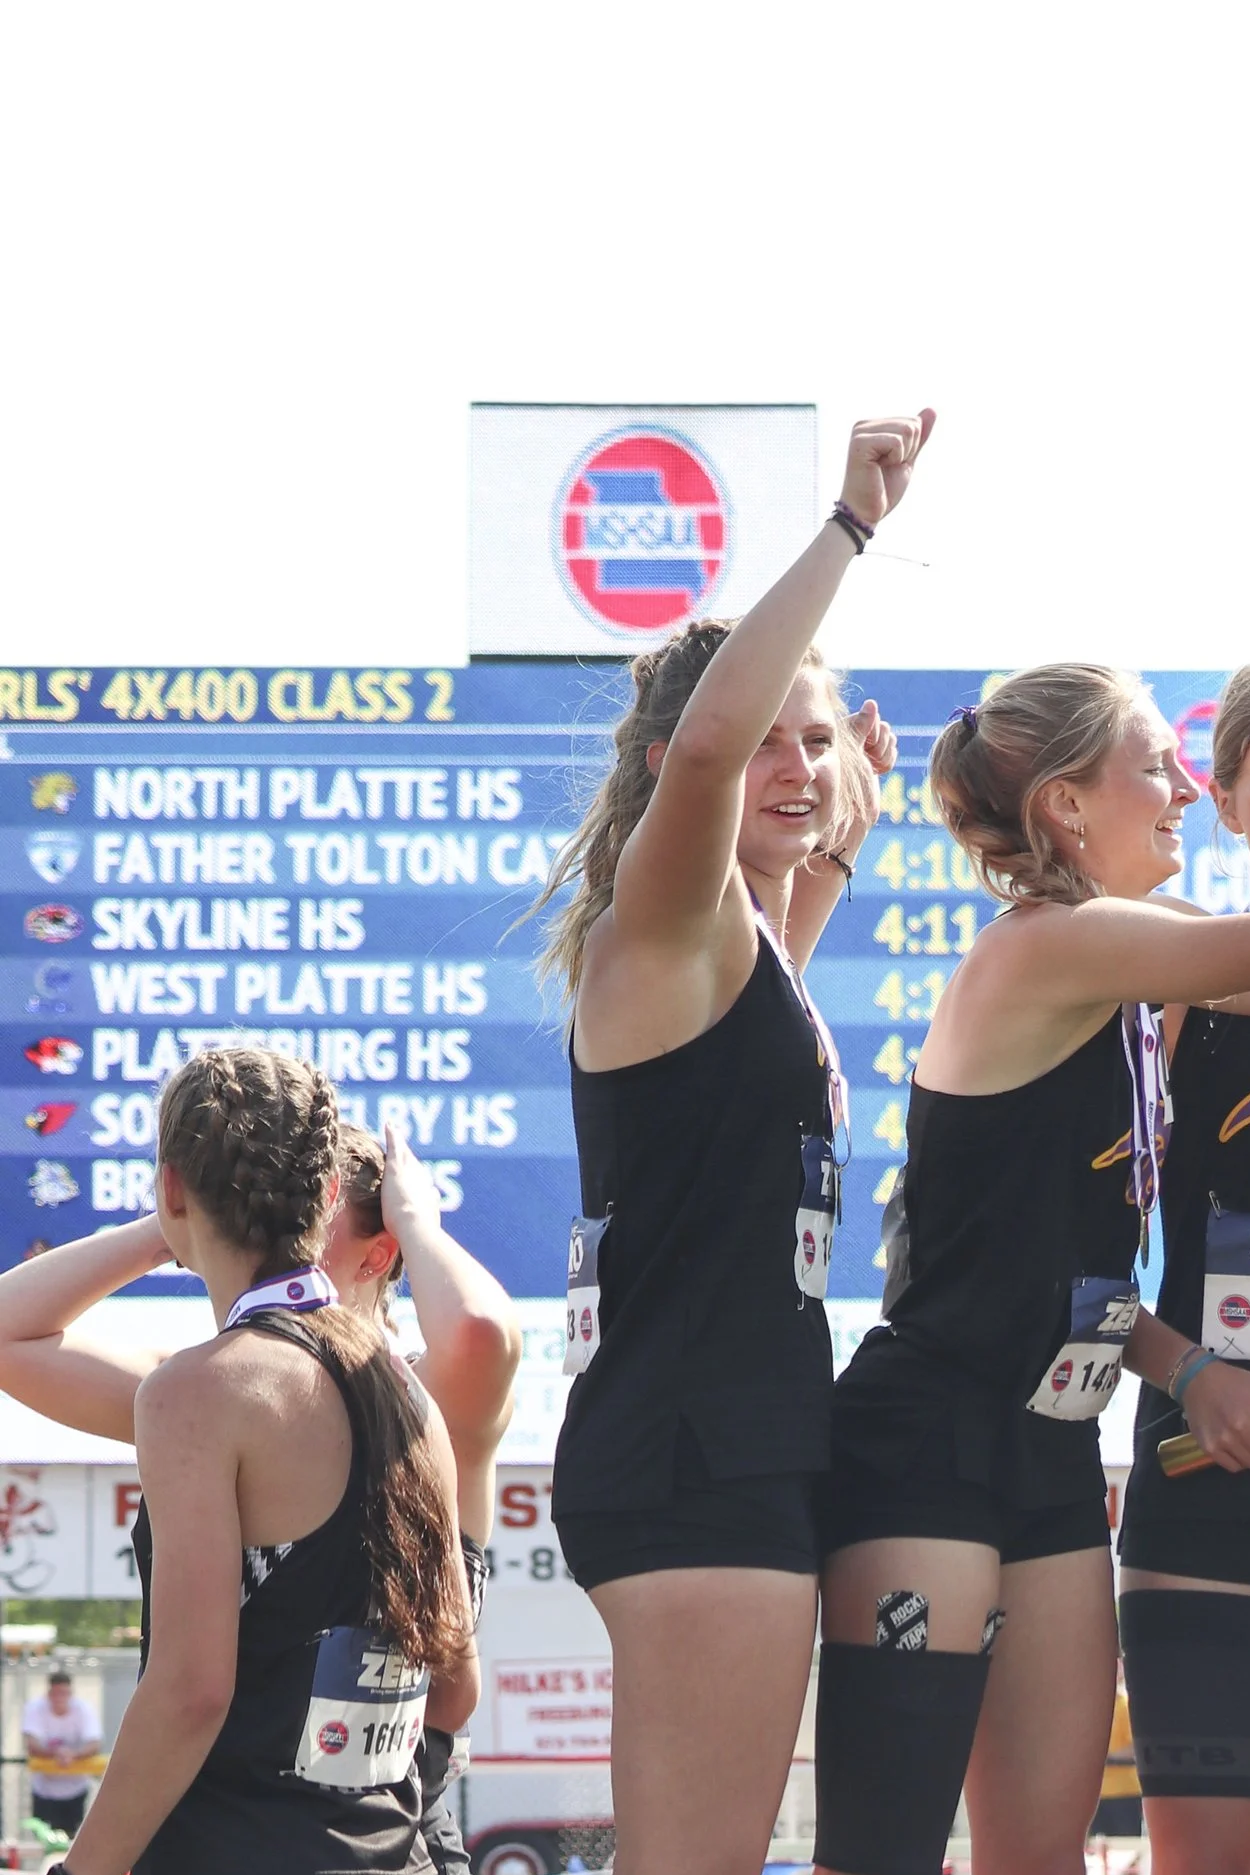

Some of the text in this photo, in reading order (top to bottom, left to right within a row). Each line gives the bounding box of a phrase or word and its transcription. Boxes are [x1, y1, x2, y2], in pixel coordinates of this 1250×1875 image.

[100, 669, 258, 722] 4X400
[267, 669, 413, 722] CLASS
[424, 671, 455, 721] 2
[93, 767, 524, 821] NORTH PLATTE HS
[93, 832, 586, 886] FATHER TOLTON CAT
[91, 898, 366, 951] SKYLINE HS
[90, 963, 488, 1015] WEST PLATTE HS
[407, 1029, 472, 1082] HS
[91, 1094, 159, 1147] SO
[453, 1094, 519, 1148] HS
[91, 1160, 157, 1212] BR
[363, 1722, 406, 1756] 1611
